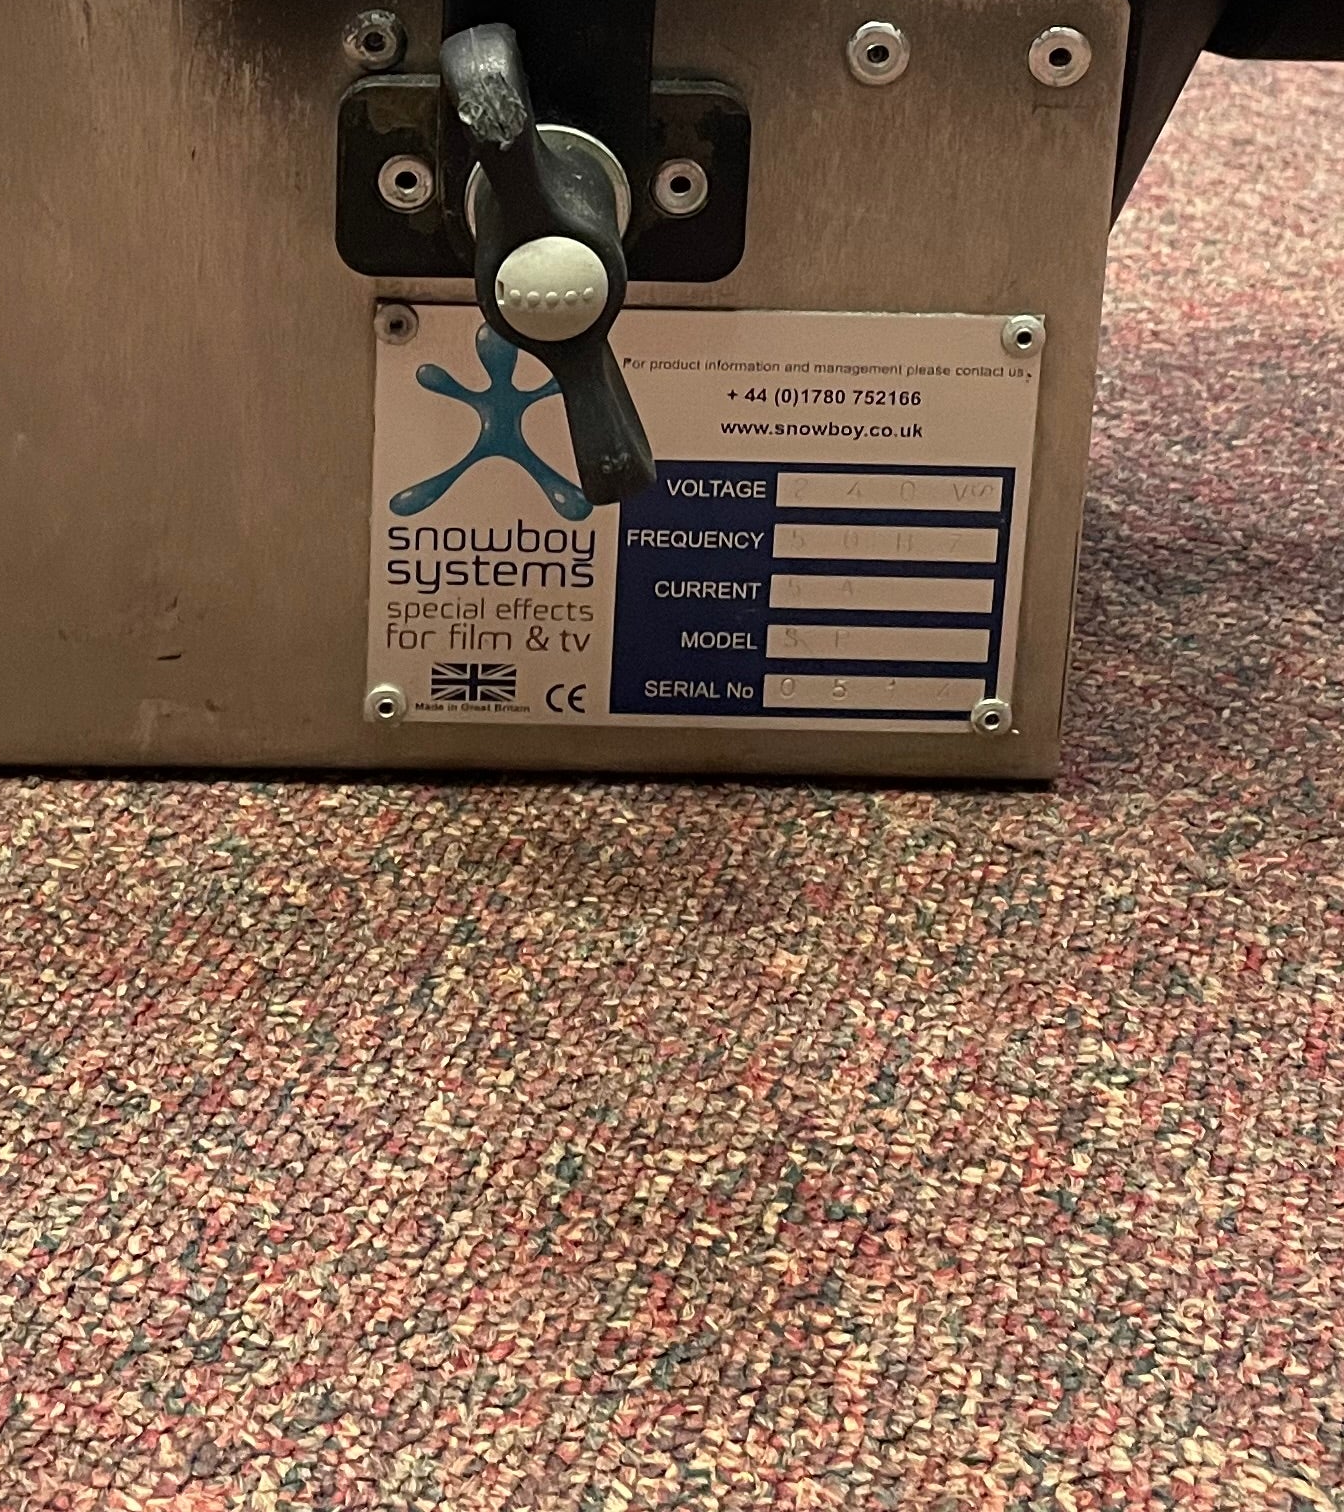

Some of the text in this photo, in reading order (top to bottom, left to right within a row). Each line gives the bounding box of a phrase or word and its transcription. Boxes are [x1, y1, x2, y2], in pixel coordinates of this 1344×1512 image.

[622, 357, 645, 370] For
[649, 359, 701, 372] product
[704, 359, 780, 373] information
[784, 361, 810, 373] and
[813, 362, 903, 376] management
[906, 364, 951, 377] please
[955, 365, 1004, 378] contact
[744, 387, 768, 402] 44
[773, 388, 846, 407] (0)1780
[852, 390, 922, 406] 752166
[720, 421, 923, 441] www.snowboy.co.uk
[666, 478, 767, 499] VOLTAGE
[387, 518, 596, 562] snowboy
[626, 529, 765, 550] FREQUENCY
[387, 555, 595, 595] systems
[654, 580, 762, 600] CURRENT
[386, 597, 594, 624] special effects
[386, 622, 591, 653] for film & tv
[681, 631, 758, 650] MODEL
[644, 680, 754, 699] SERIAL No
[415, 702, 531, 713] Made in Great Britain
